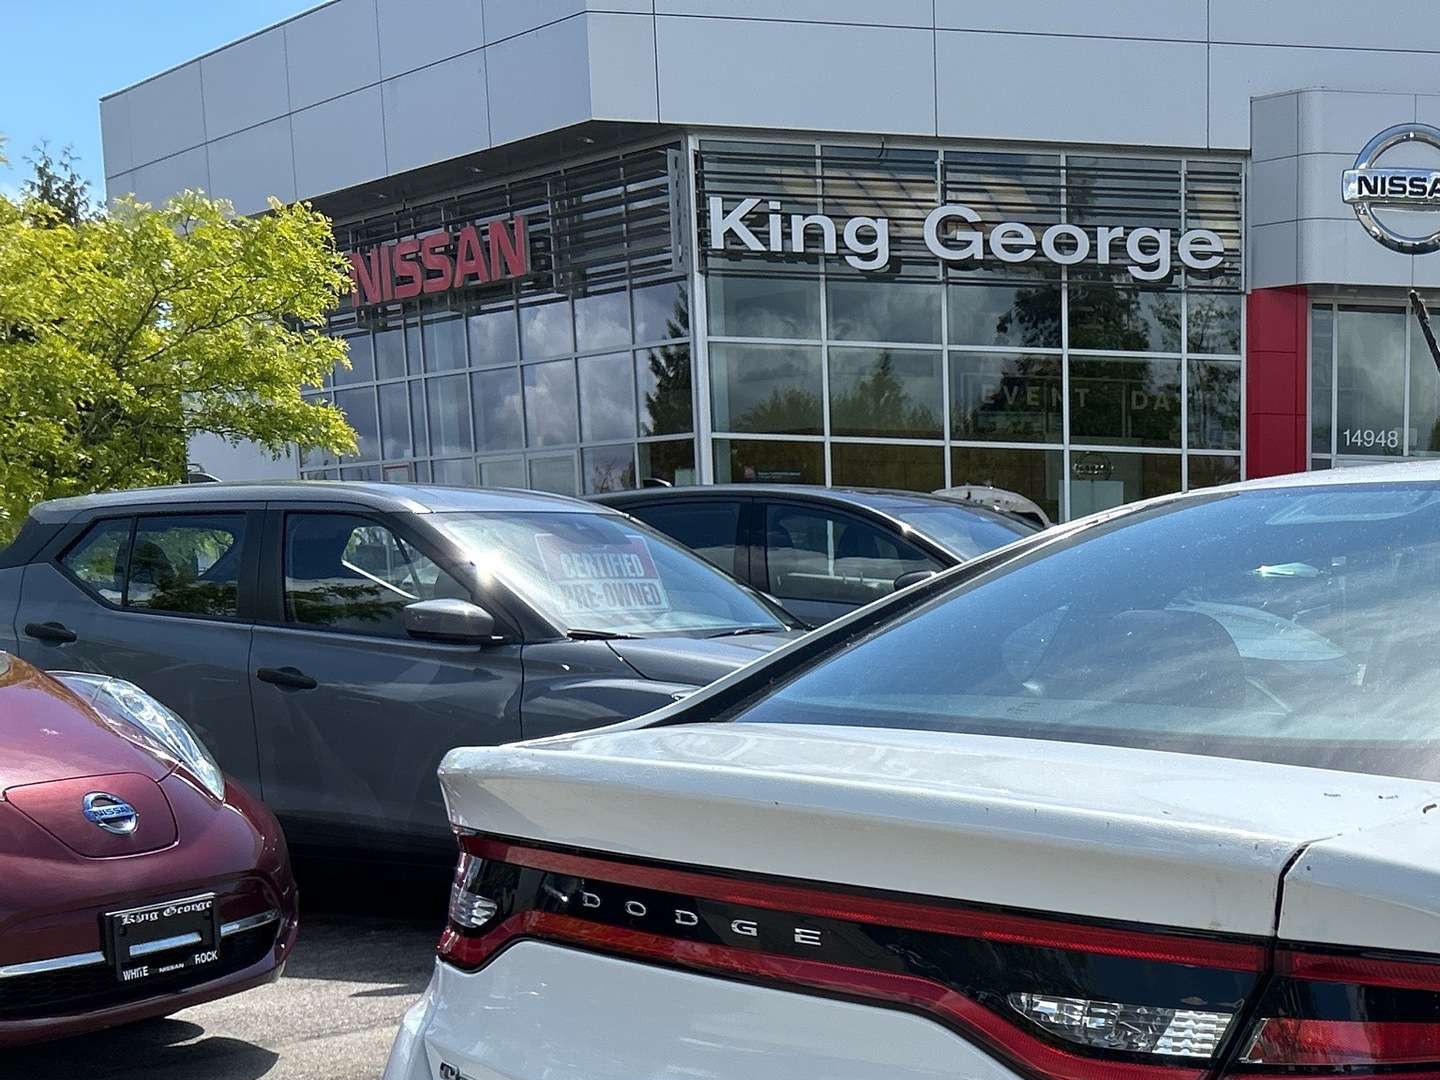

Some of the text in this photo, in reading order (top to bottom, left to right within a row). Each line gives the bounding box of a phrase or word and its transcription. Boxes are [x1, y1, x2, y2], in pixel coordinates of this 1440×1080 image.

[708, 195, 1225, 281] King George
[351, 214, 528, 308] NISSAN
[1342, 428, 1399, 448] 14948
[560, 552, 645, 578] CERTIFIED
[560, 581, 662, 609] PRE-OWNED
[581, 891, 822, 946] DODGE
[123, 965, 149, 981] WHITE
[195, 950, 218, 965] ROCK
